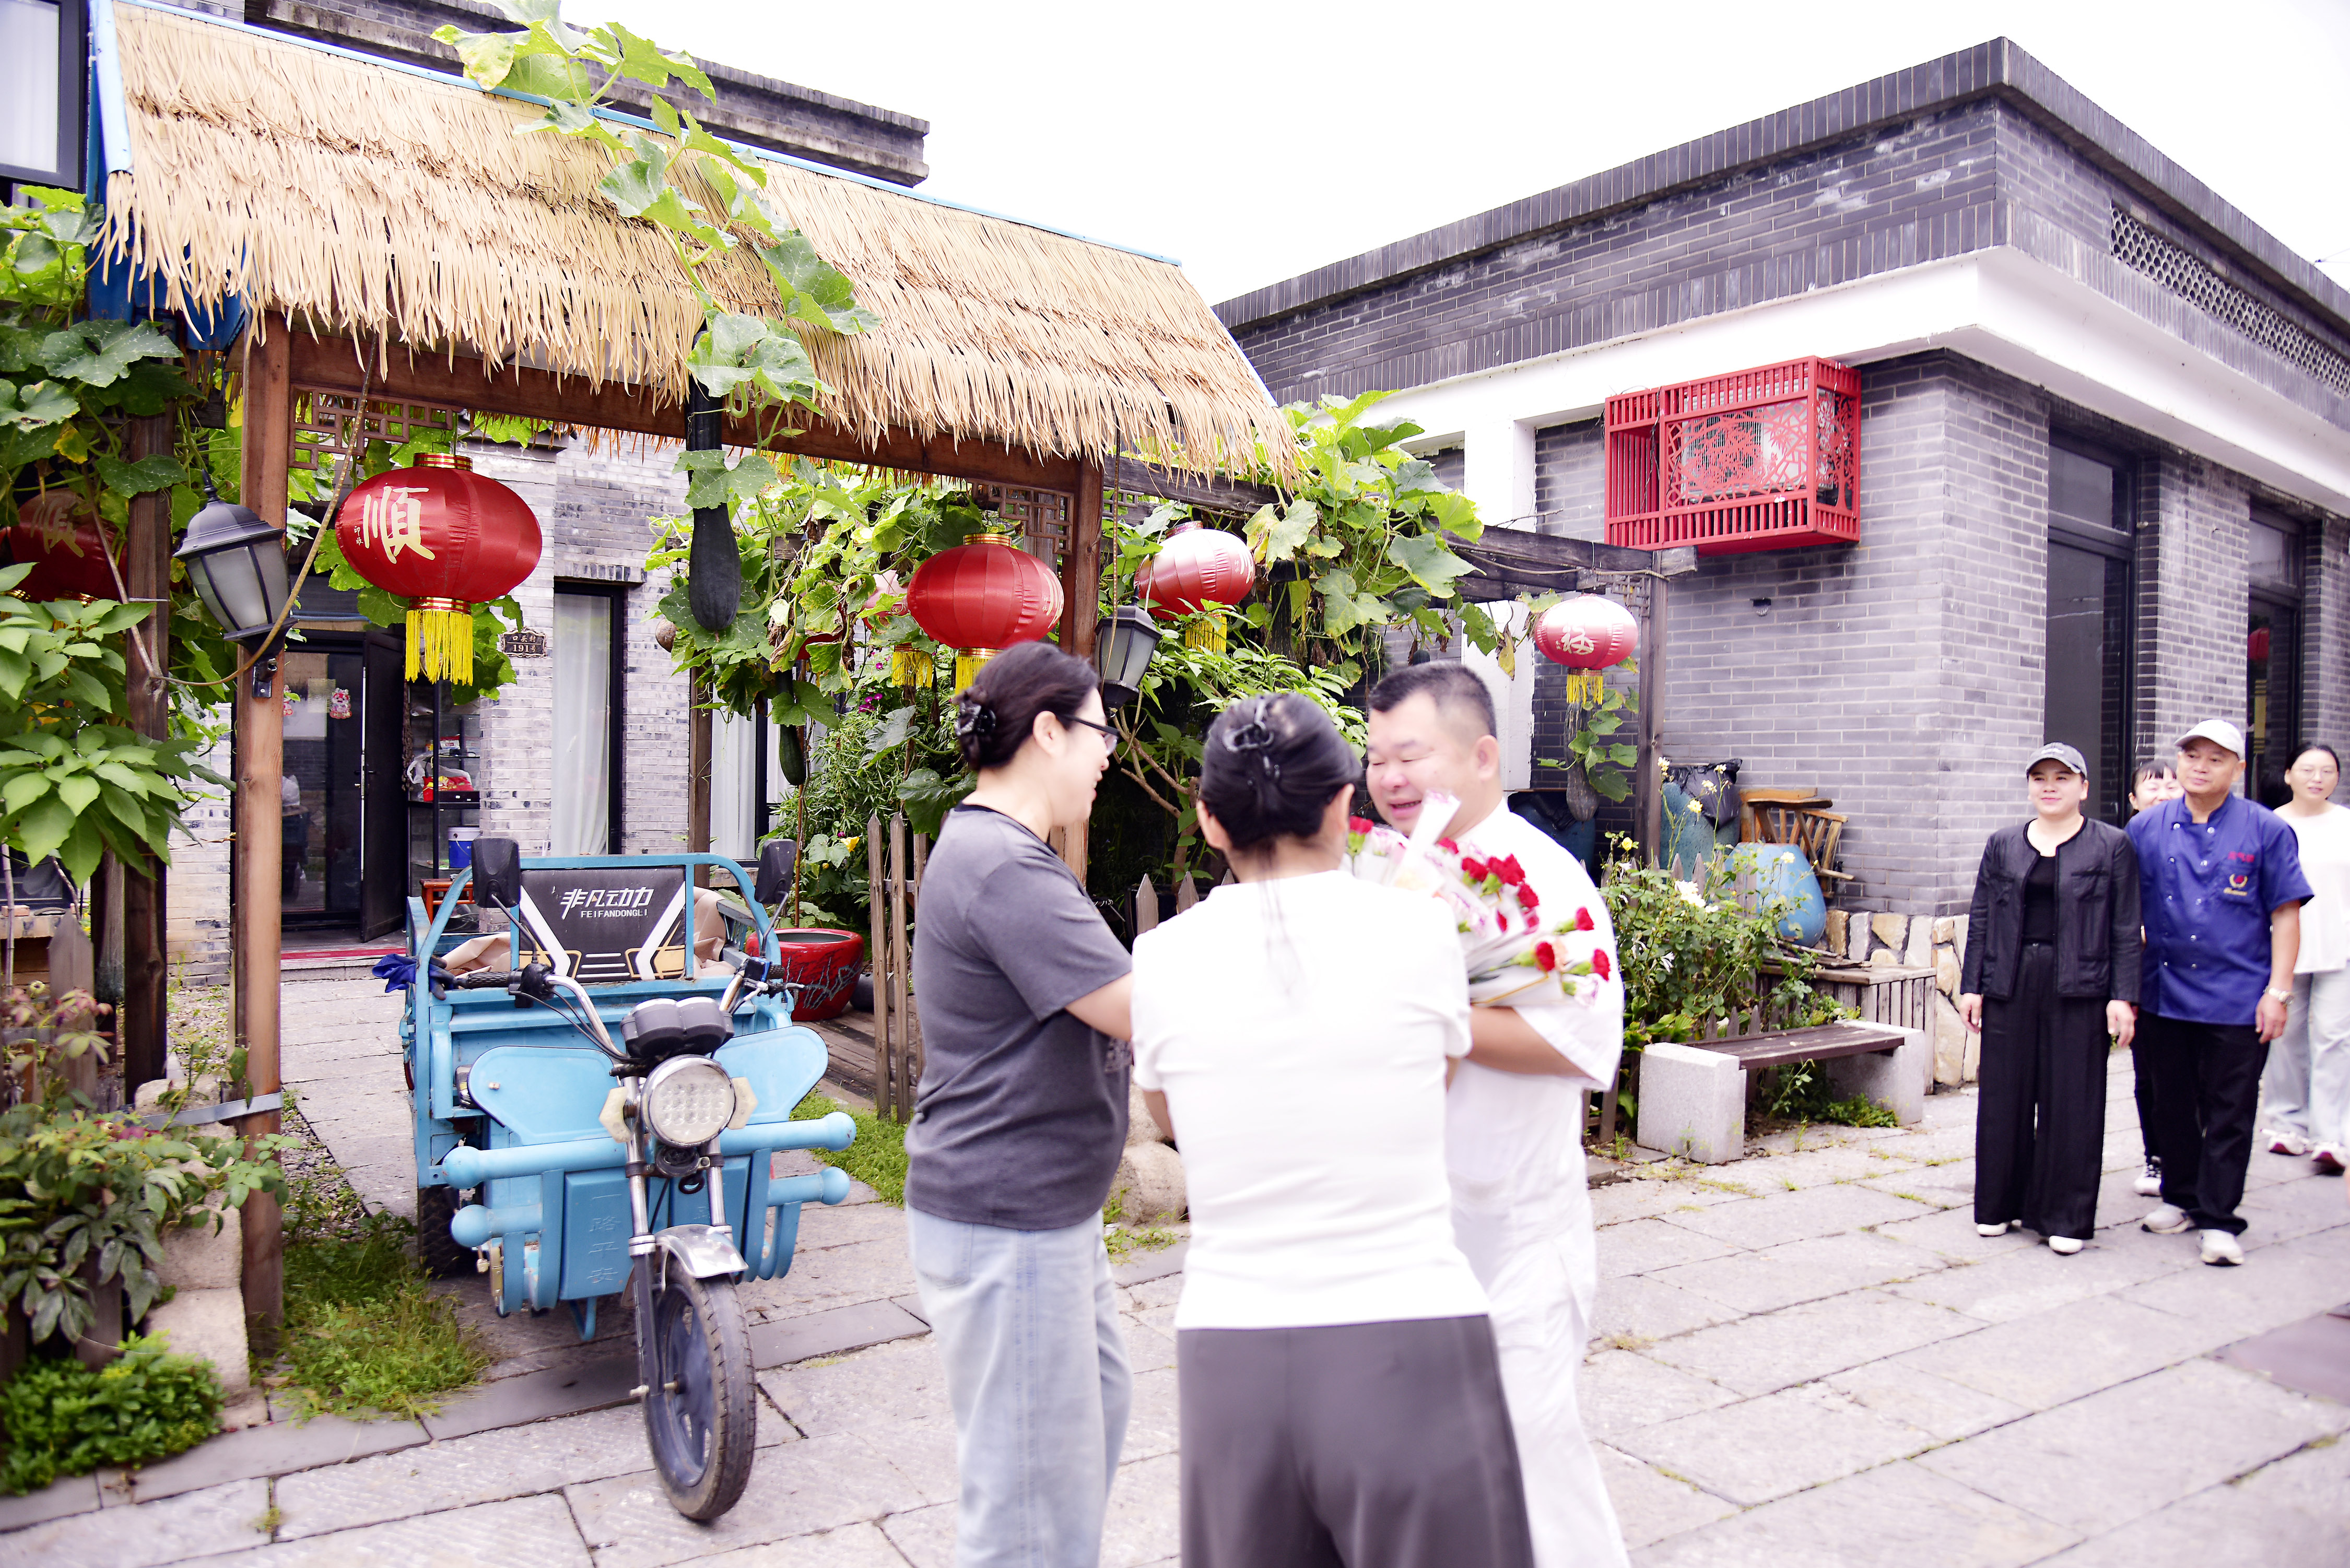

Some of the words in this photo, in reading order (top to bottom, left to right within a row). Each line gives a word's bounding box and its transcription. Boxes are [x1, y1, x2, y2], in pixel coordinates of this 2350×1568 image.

[560, 887, 654, 920] 非凡动力
[587, 1194, 621, 1283] 一路平安
